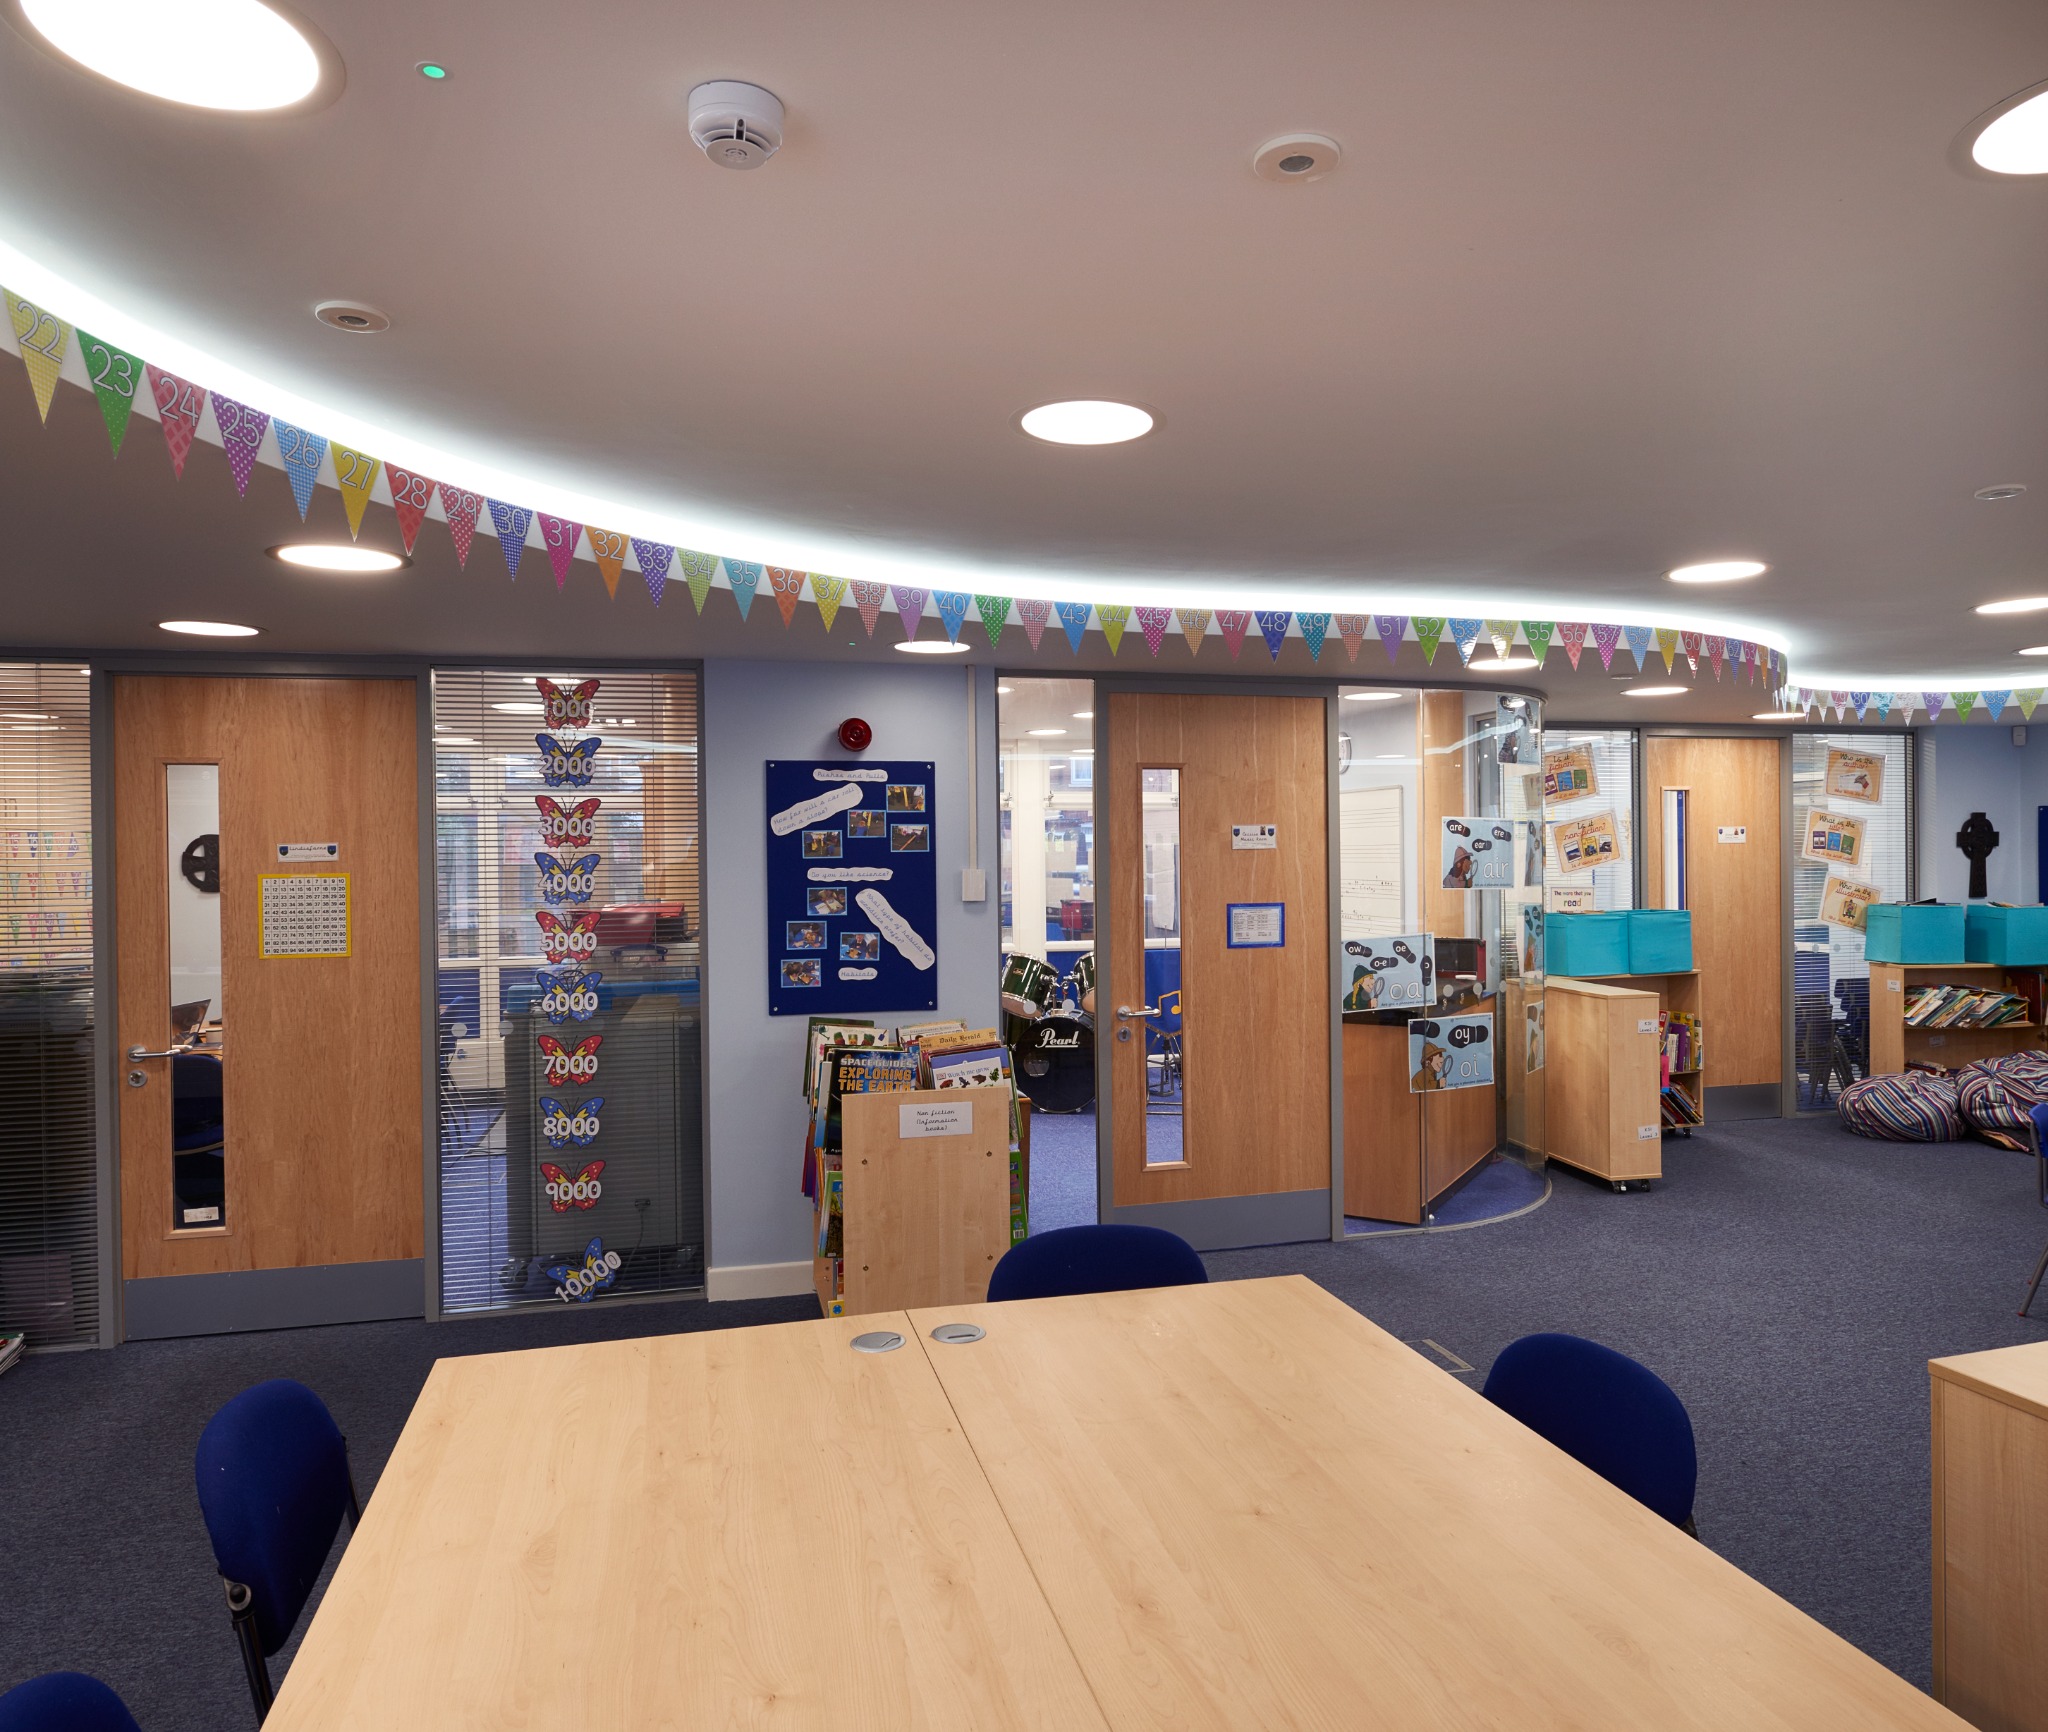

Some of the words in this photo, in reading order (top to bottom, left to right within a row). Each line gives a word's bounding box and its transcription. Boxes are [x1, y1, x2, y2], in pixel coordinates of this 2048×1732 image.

[17, 300, 62, 364] 22
[92, 344, 134, 398] 23
[159, 376, 199, 427] 24
[222, 402, 260, 447] 25
[284, 426, 320, 469] 26
[341, 451, 374, 490] 27
[394, 471, 427, 510] 28
[446, 489, 477, 525] 29
[497, 504, 527, 537] 30
[548, 518, 573, 551] 31
[594, 530, 623, 561] 32
[641, 543, 669, 572] 33
[684, 551, 712, 580] 34
[730, 560, 758, 587] 35
[773, 567, 800, 594] 36
[816, 575, 844, 601] 37
[856, 581, 882, 605] 38
[898, 588, 923, 611] 39
[939, 593, 966, 616] 40
[982, 596, 1004, 619] 41
[1022, 600, 1047, 622] 42
[1062, 603, 1086, 625] 43
[1100, 605, 1126, 627] 44
[1142, 607, 1167, 629] 45
[1181, 608, 1207, 630] 46
[1221, 611, 1246, 632] 47
[1261, 612, 1287, 632] 48
[1303, 613, 1325, 633] 49
[1341, 615, 1365, 635] 50
[1381, 616, 1401, 636] 51
[1417, 617, 1440, 637] 52
[1455, 619, 1477, 638] 53
[1492, 620, 1514, 640] 54
[1528, 623, 1551, 641] 55
[1564, 624, 1584, 643] 56
[1597, 624, 1618, 644] 57
[1629, 627, 1649, 645] 58
[1660, 630, 1676, 648] 59
[1684, 633, 1701, 651] 60
[1708, 636, 1723, 654] 61
[1728, 640, 1740, 658] 62
[1744, 643, 1756, 660] 63
[1853, 692, 1868, 704] 80
[1925, 692, 1944, 705] 83
[1955, 692, 1973, 705] 84
[1985, 691, 2007, 704] 85
[542, 699, 594, 718] 1000
[539, 754, 596, 777] 2000
[1549, 759, 1575, 773] fiction?
[1842, 761, 1868, 769] author?
[538, 816, 596, 837] 3000
[1820, 815, 1835, 823] What
[1494, 828, 1504, 837] ere
[1564, 822, 1606, 840] non-fiction?
[1483, 857, 1508, 879] air
[538, 873, 595, 893] 4000
[1839, 881, 1852, 890] Who
[1564, 898, 1581, 907] read
[1836, 888, 1871, 901] illustrator?
[540, 932, 597, 952] 5000
[1390, 981, 1421, 1000] oa
[542, 992, 598, 1013] 6000
[939, 1036, 957, 1044] Daily
[959, 1033, 981, 1041] Herald
[1035, 1028, 1079, 1048] Pearl
[1455, 1027, 1470, 1044] oy
[542, 1055, 598, 1076] 7000
[841, 1058, 873, 1066] SPACE
[875, 1060, 913, 1068] GUIDES
[975, 1067, 990, 1075] grow
[1461, 1054, 1479, 1077] oi
[839, 1067, 912, 1081] EXPLORING
[838, 1079, 864, 1091] THE
[868, 1080, 911, 1092] EARTH
[543, 1116, 599, 1137] 8000
[545, 1180, 602, 1201] 9000
[555, 1251, 621, 1302] 10000
